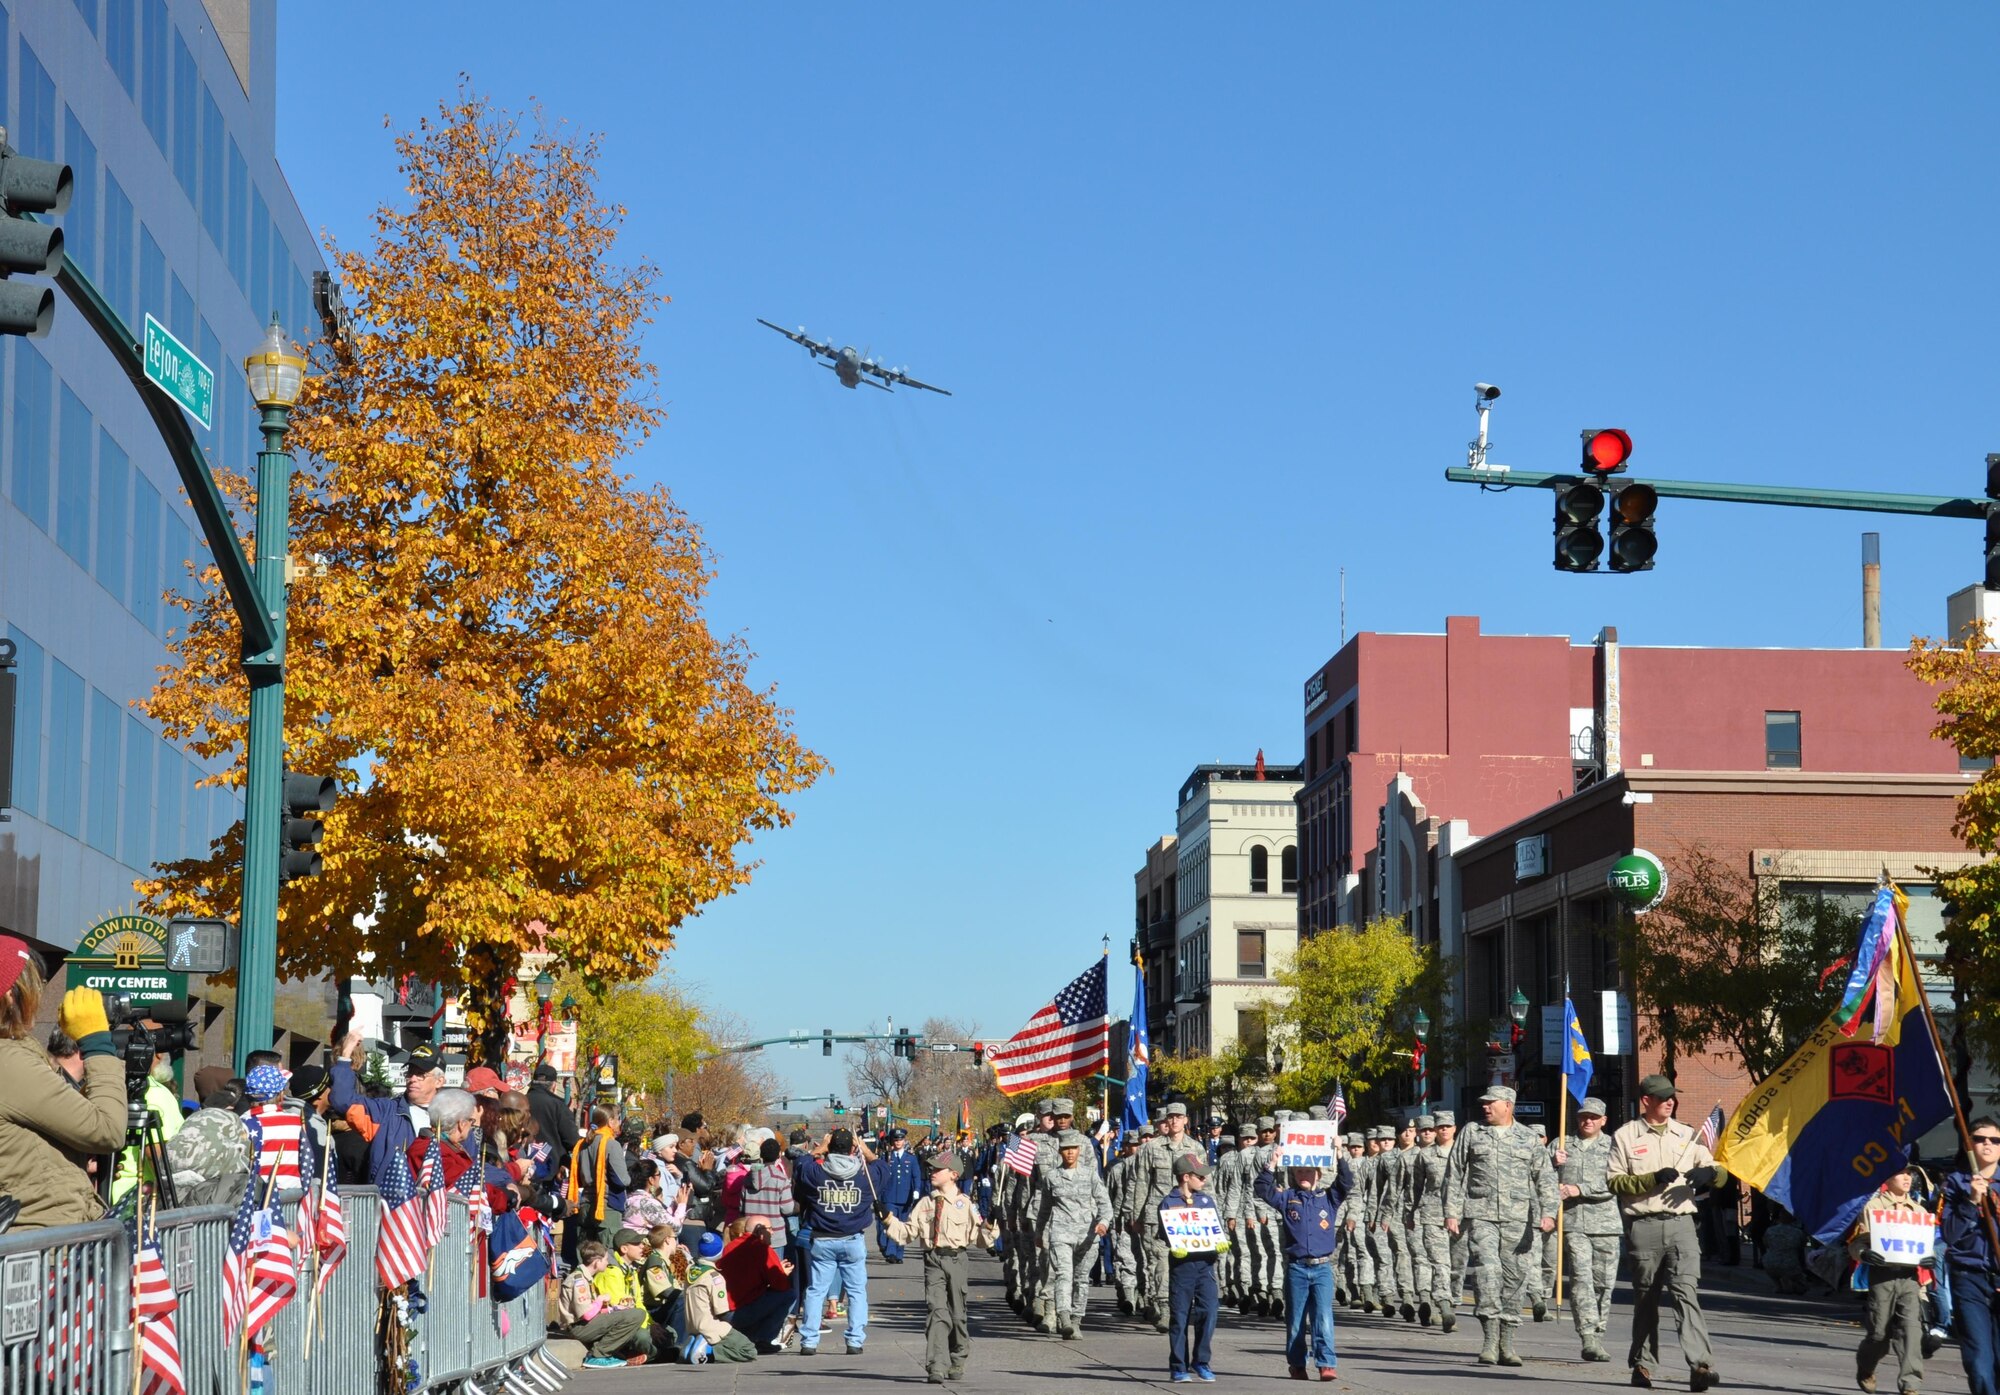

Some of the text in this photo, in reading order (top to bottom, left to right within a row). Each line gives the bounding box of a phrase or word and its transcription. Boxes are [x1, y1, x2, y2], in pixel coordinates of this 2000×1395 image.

[149, 327, 178, 383] Tejon
[84, 917, 168, 948] DOWNTOW
[86, 976, 168, 989] CITY CENTER
[140, 992, 173, 1000] CORNER
[1286, 1133, 1325, 1146] FREE
[1282, 1154, 1332, 1167] BRAVE
[824, 1190, 856, 1203] IRISH
[1179, 1211, 1200, 1223] WE
[1872, 1210, 1933, 1227] THANK
[1166, 1225, 1222, 1236] SALUTE
[1181, 1239, 1211, 1248] YOU
[1880, 1237, 1925, 1255] VETS
